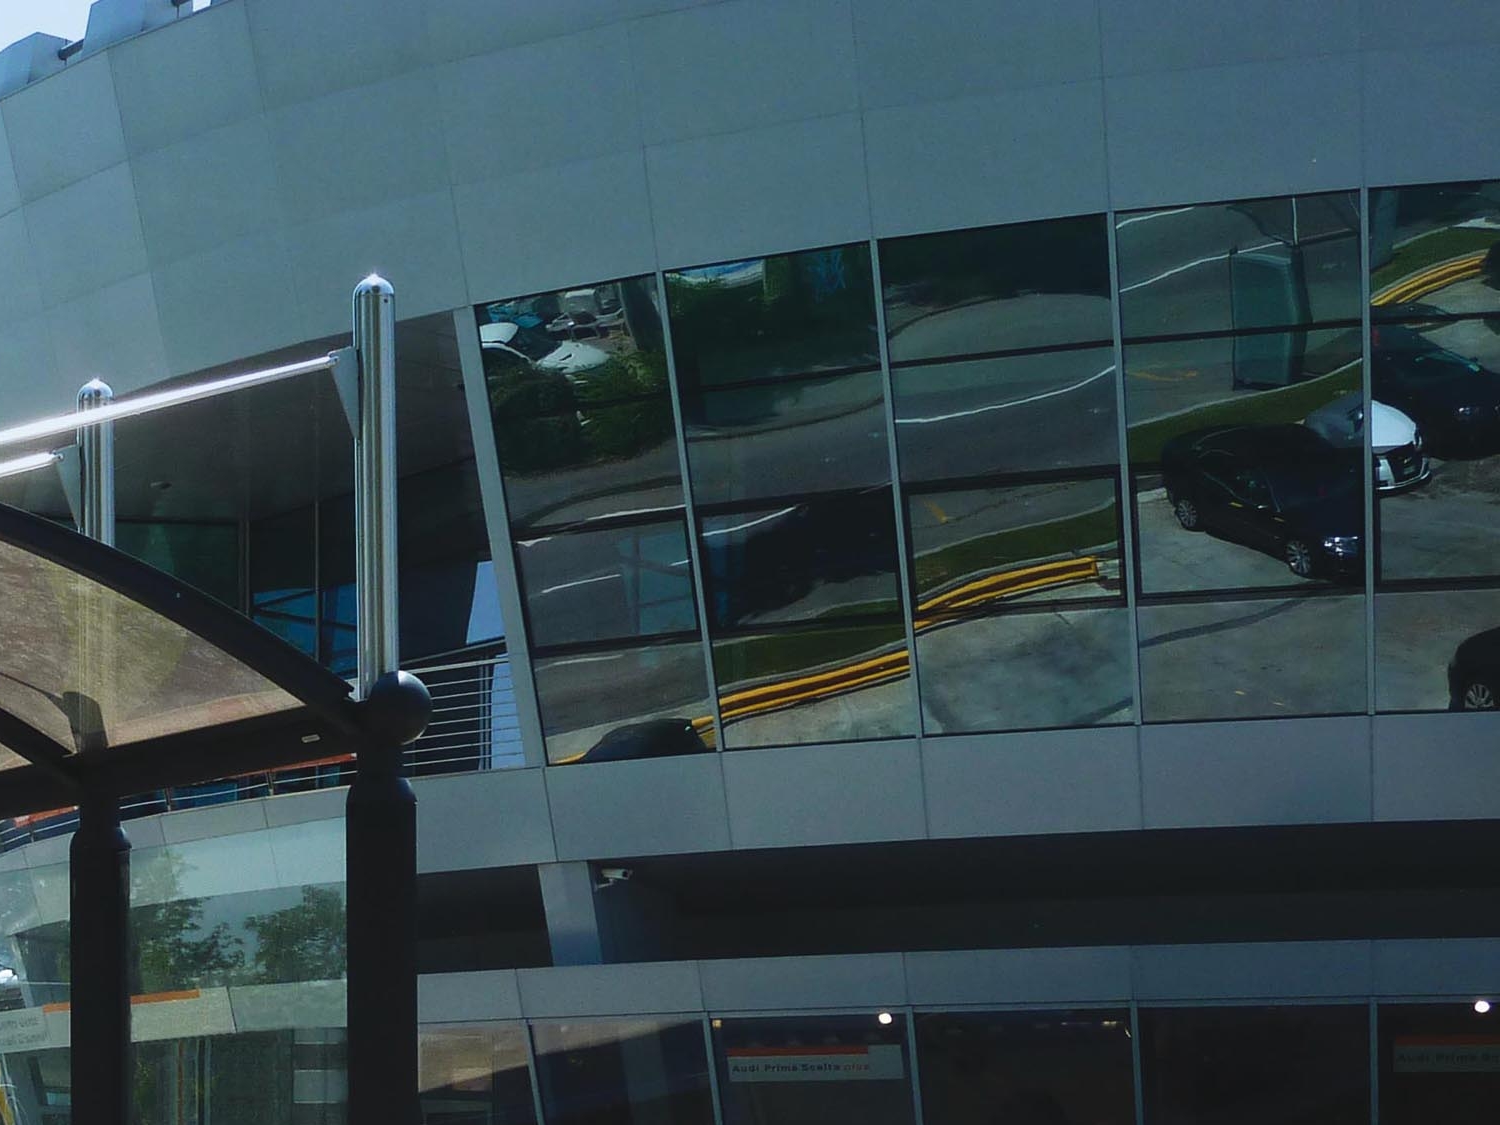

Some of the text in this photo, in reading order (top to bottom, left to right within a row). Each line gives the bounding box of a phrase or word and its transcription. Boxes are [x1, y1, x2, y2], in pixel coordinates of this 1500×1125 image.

[731, 1063, 760, 1073] Audi
[764, 1063, 798, 1072] Prima
[802, 1062, 841, 1072] Scelta
